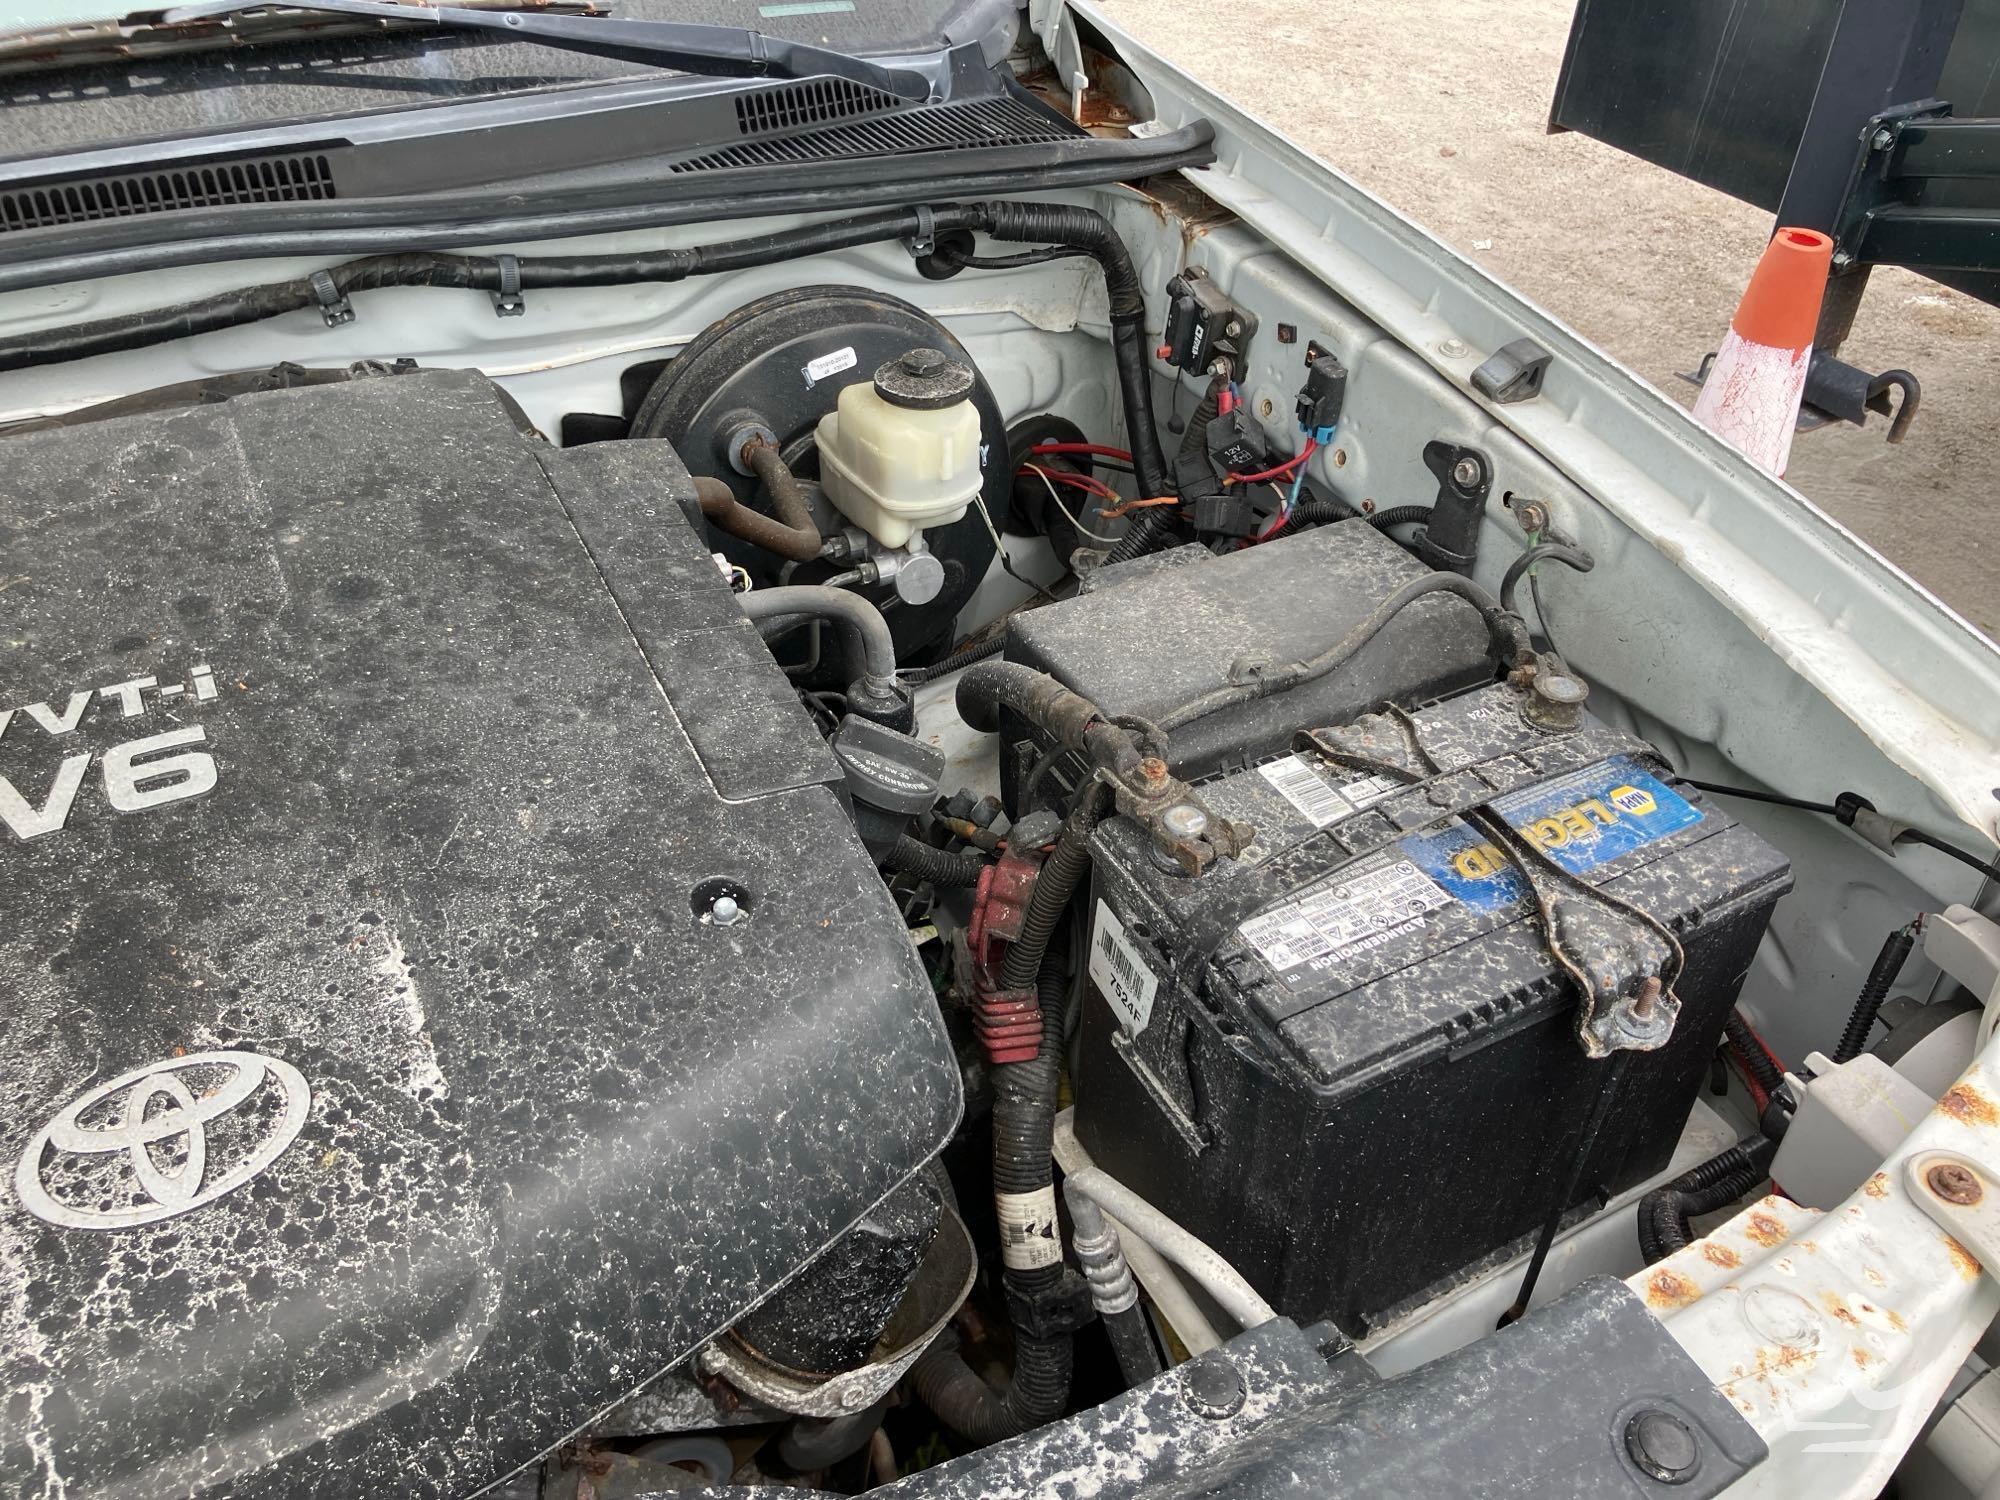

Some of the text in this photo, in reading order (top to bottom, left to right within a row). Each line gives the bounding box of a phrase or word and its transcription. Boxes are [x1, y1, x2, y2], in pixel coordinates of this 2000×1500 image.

[1224, 444, 1241, 458] 12V
[0, 665, 218, 736] VT-i
[0, 725, 218, 840] V6
[1617, 791, 1650, 810] NAPA
[1286, 973, 1301, 984] 12V
[1109, 972, 1142, 1023] 7524F
